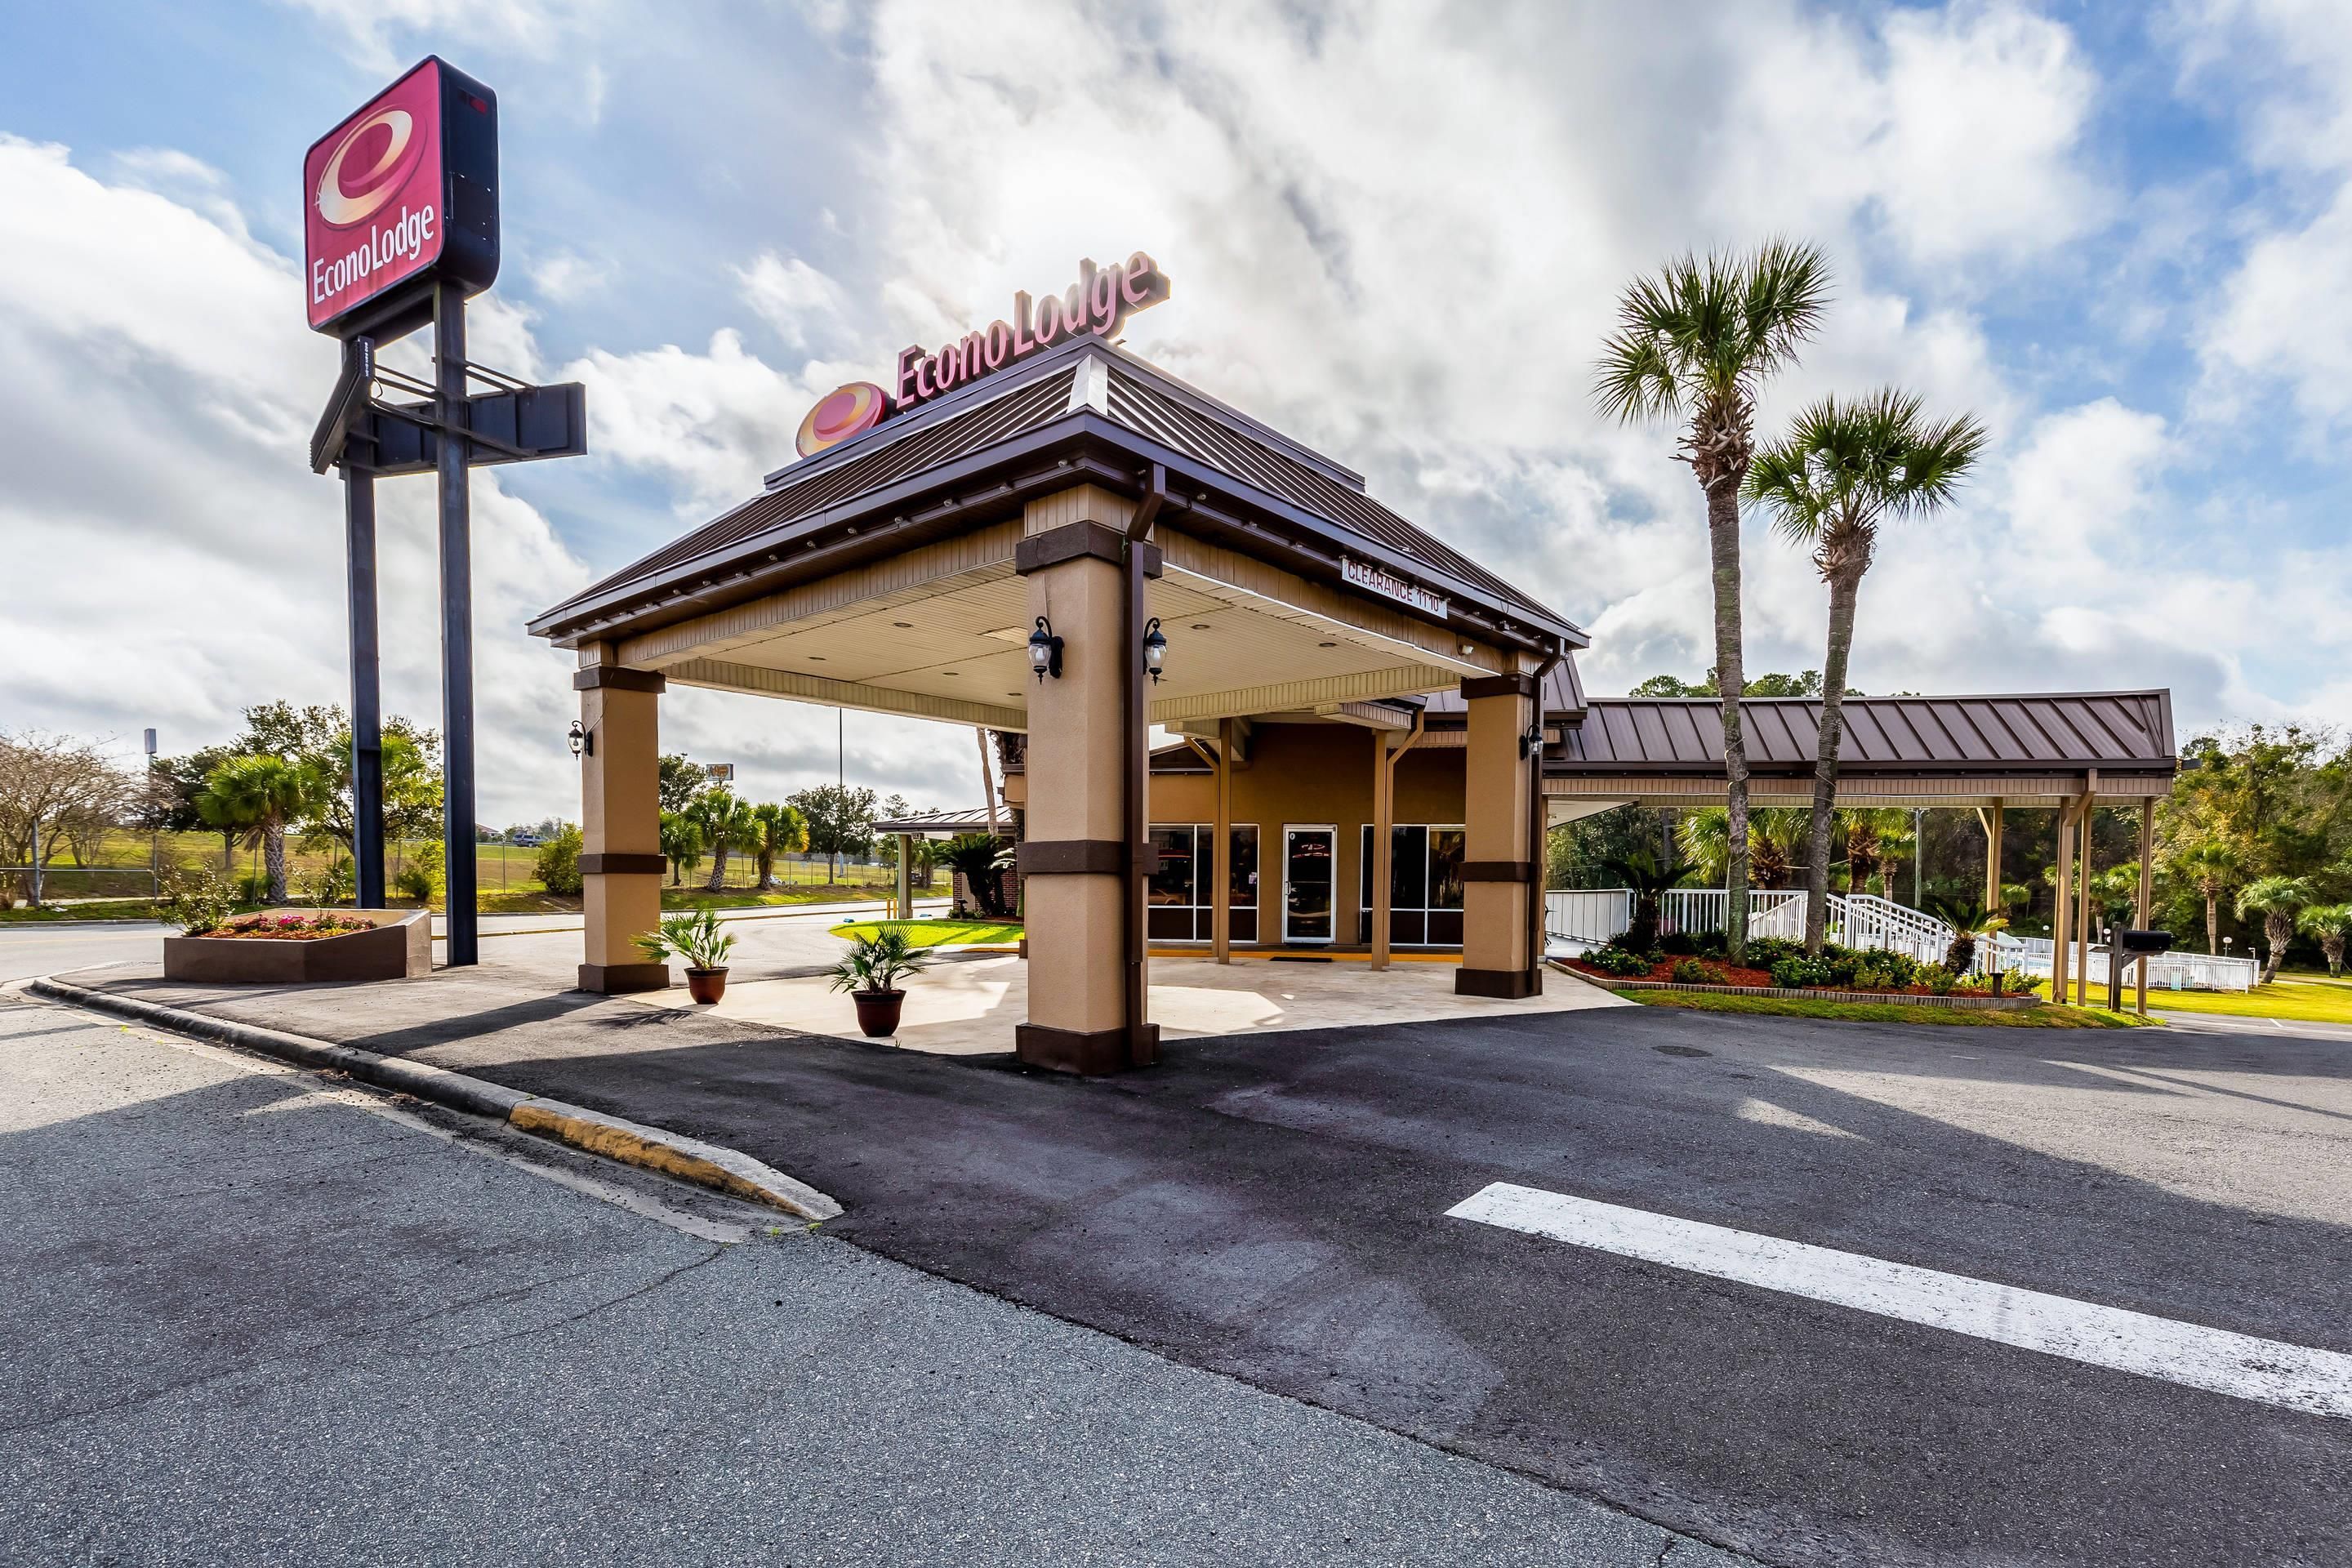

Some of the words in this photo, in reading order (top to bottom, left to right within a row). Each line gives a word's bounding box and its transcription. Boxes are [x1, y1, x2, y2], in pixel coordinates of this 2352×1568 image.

[314, 205, 434, 305] EconoLodge
[897, 251, 1153, 409] EconoLodge
[1348, 562, 1413, 602] CLEARANCE
